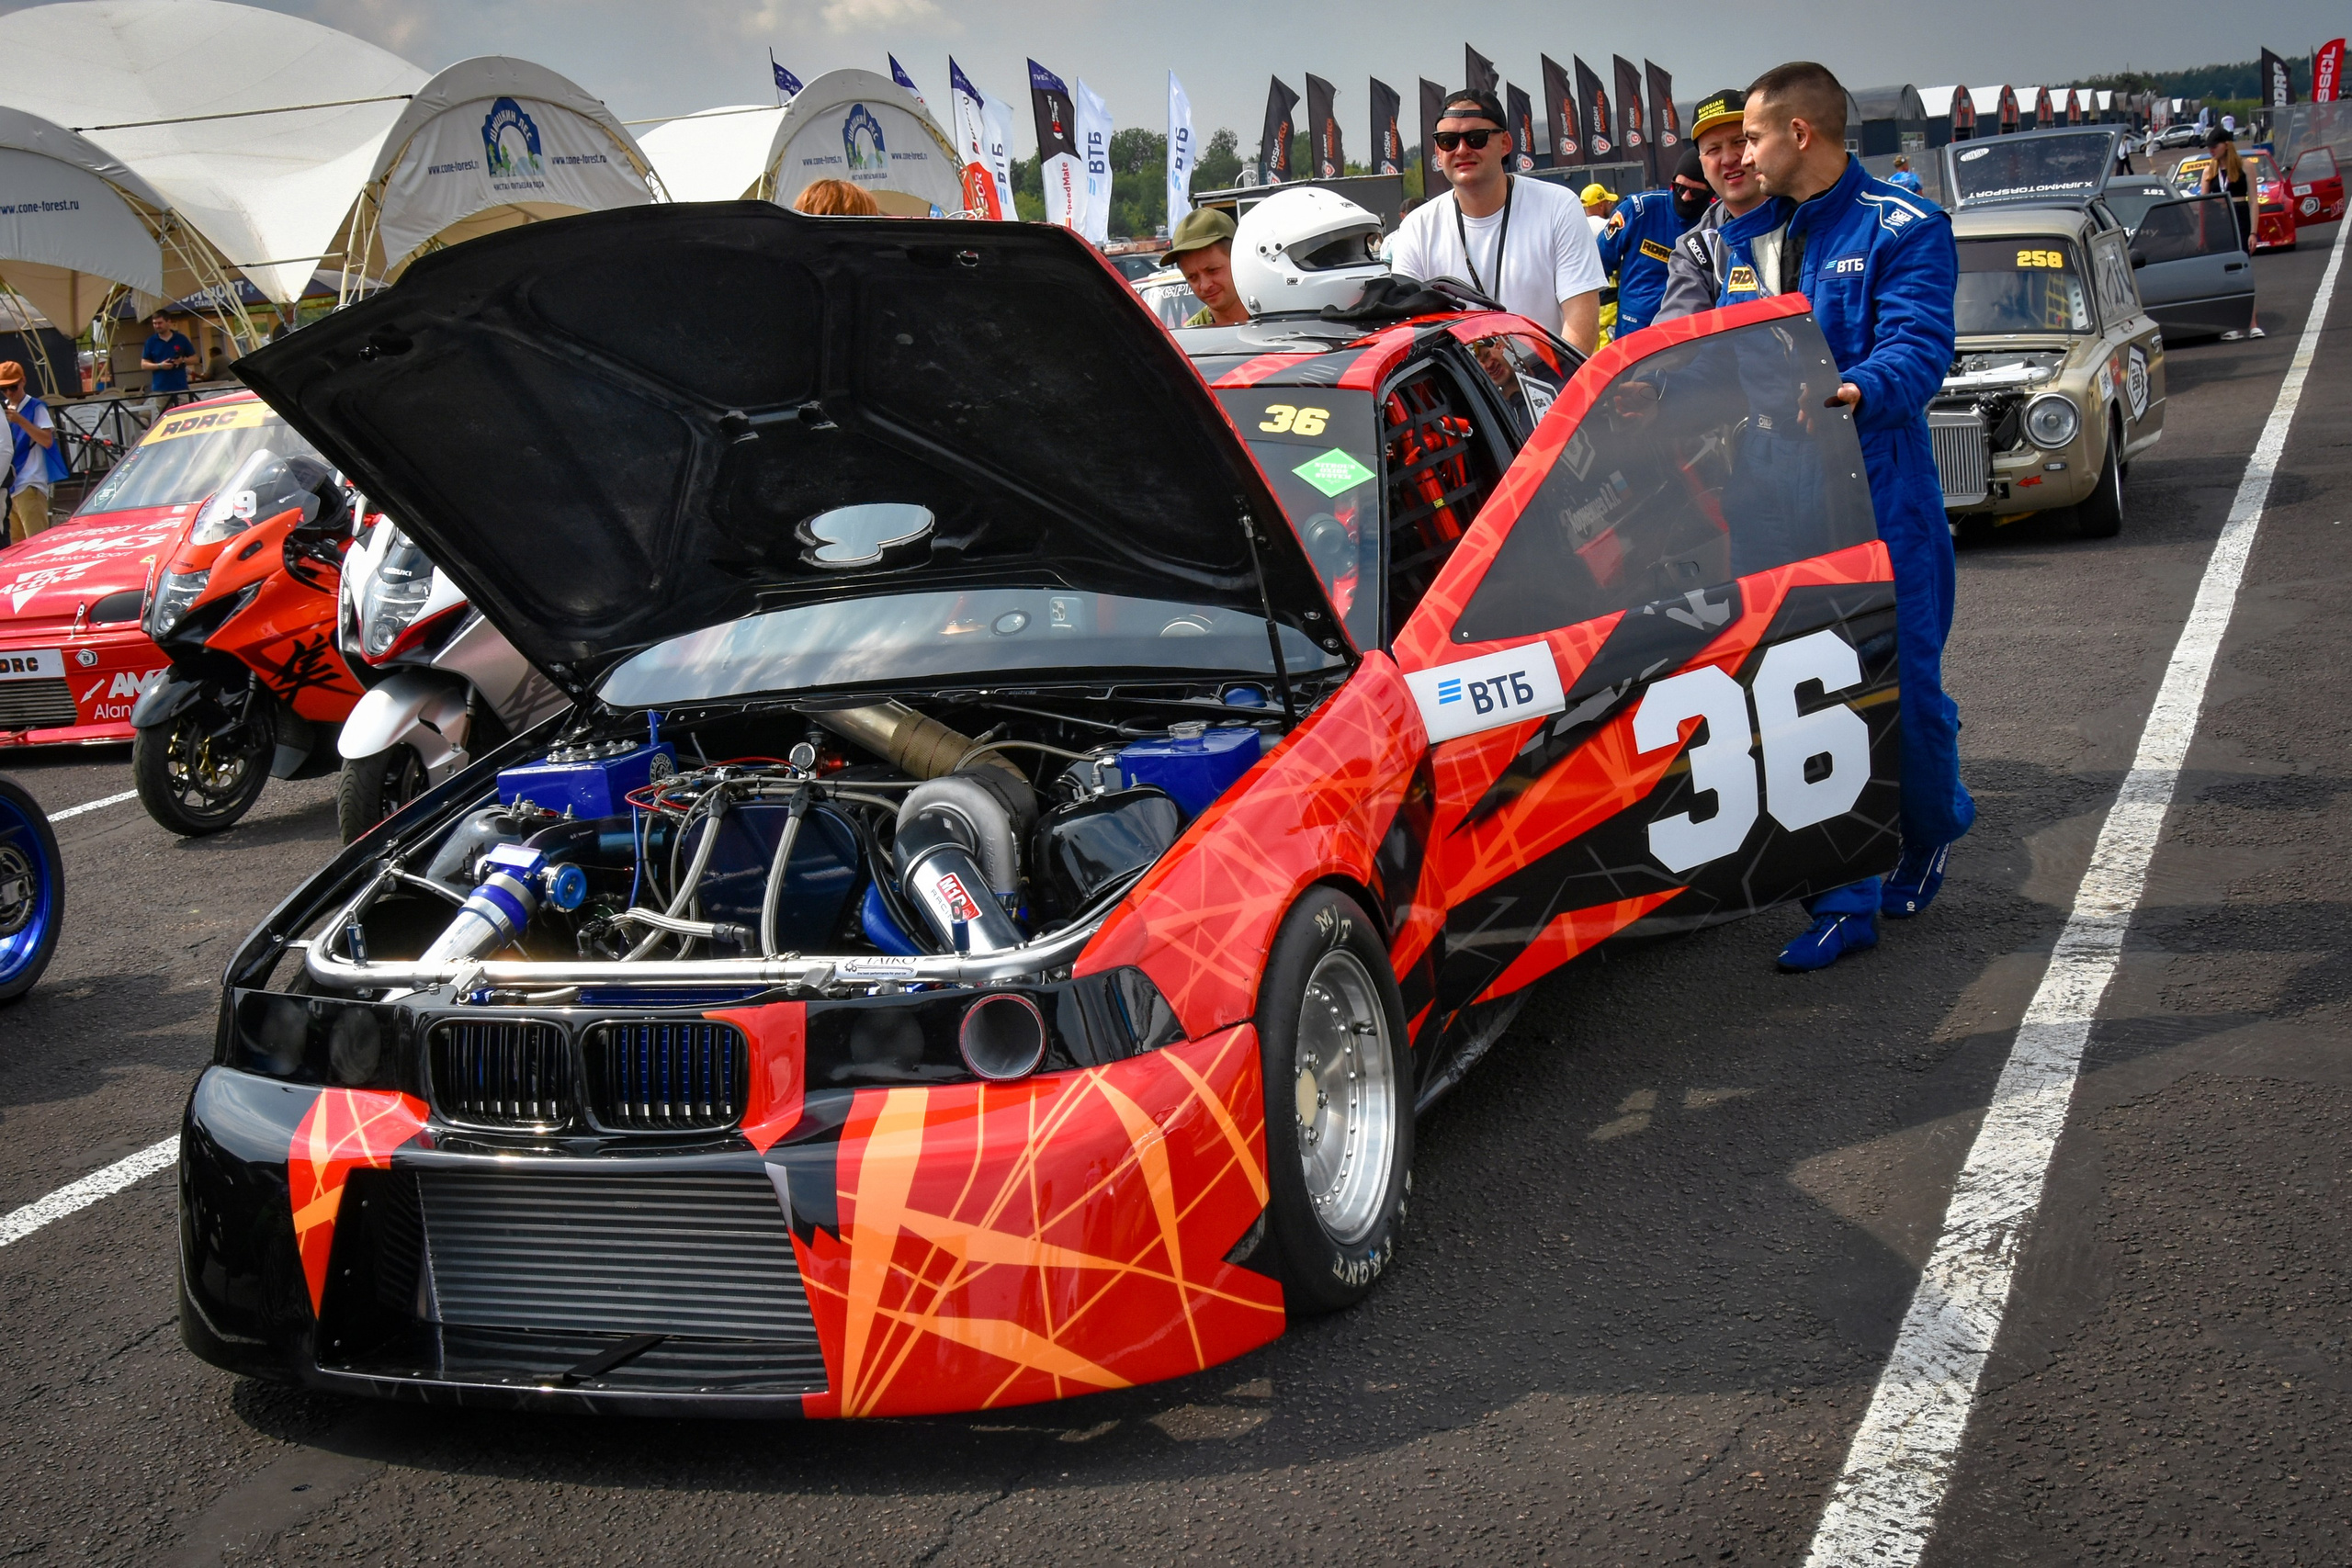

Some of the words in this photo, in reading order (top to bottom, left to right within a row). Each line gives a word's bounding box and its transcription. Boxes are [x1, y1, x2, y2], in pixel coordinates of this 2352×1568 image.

[2317, 46, 2336, 103] SSOL
[1592, 106, 1601, 132] GOSHA
[1698, 99, 1724, 115] RUSSIAN
[490, 109, 516, 142] ШИШКИН
[518, 118, 533, 141] ЛЕС
[1088, 131, 1105, 175] ВТБ
[1175, 127, 1189, 172] ВТБ
[1270, 138, 1279, 169] GOSHA
[1061, 162, 1072, 216] SpeedMate
[1687, 237, 1708, 265] sparco
[1837, 258, 1865, 273] ВТБ
[2017, 250, 2064, 268] 258
[160, 411, 238, 437] RDRC
[1259, 404, 1330, 436] 36
[24, 533, 170, 560] AMS
[107, 668, 165, 699] AM
[1467, 670, 1534, 716] ВТБ
[94, 704, 135, 720] Alan
[1632, 629, 1871, 874] 36
